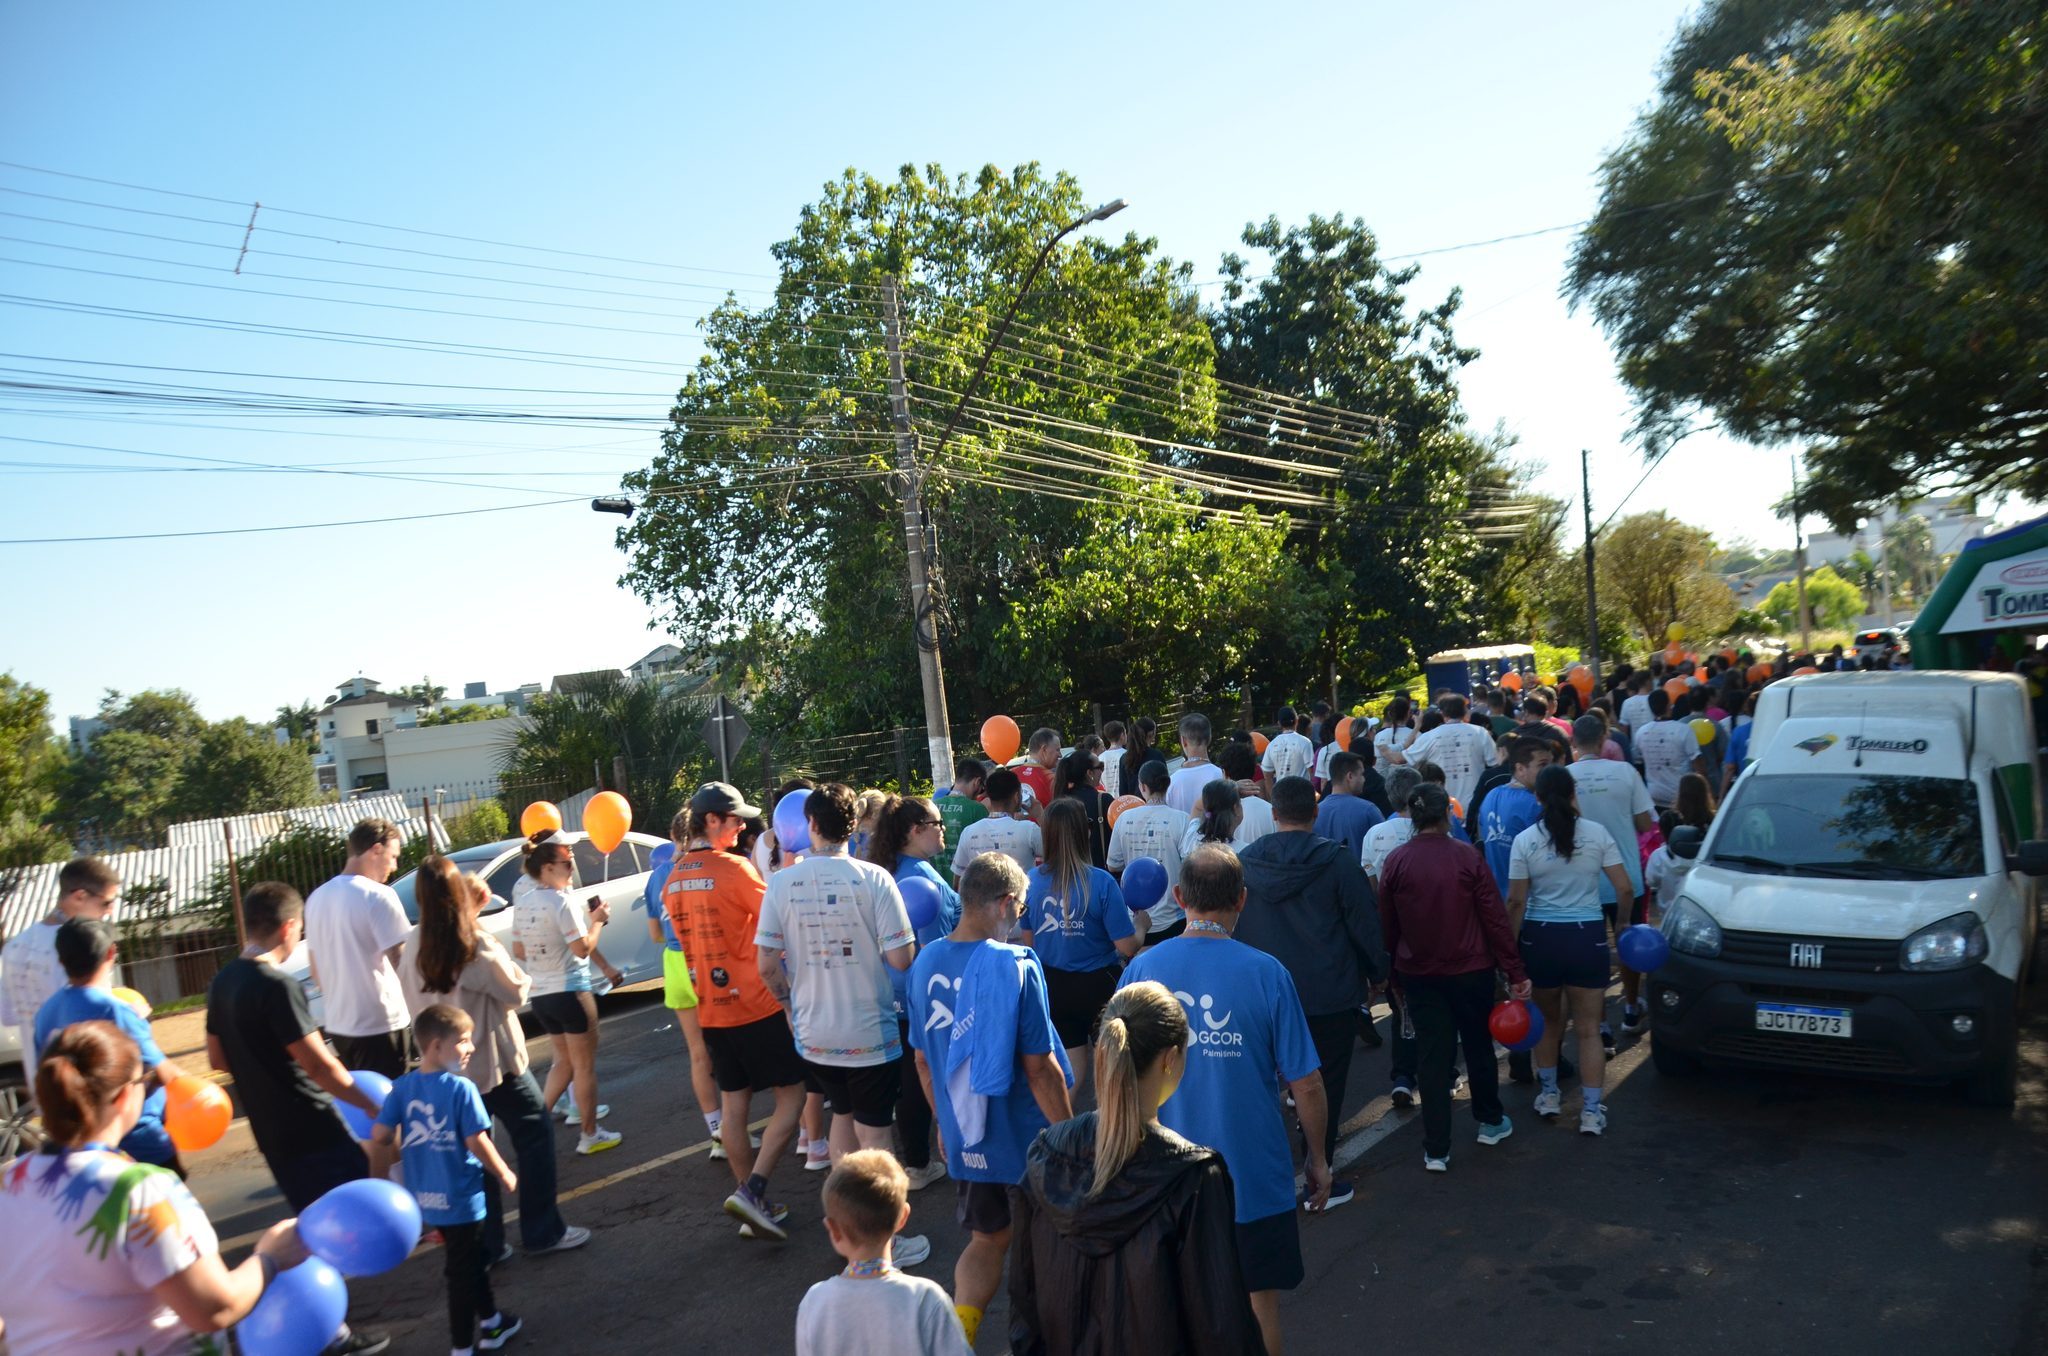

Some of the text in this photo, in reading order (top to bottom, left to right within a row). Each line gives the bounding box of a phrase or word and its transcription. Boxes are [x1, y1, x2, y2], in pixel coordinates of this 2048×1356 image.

[1847, 735, 1929, 754] TOMELERO
[936, 803, 963, 813] TLETA
[1790, 943, 1824, 968] FIAT
[951, 1007, 975, 1040] alm
[1764, 1012, 1841, 1034] JCT7B73
[1202, 1048, 1242, 1058] Palmitinho
[961, 1151, 988, 1170] RUDI
